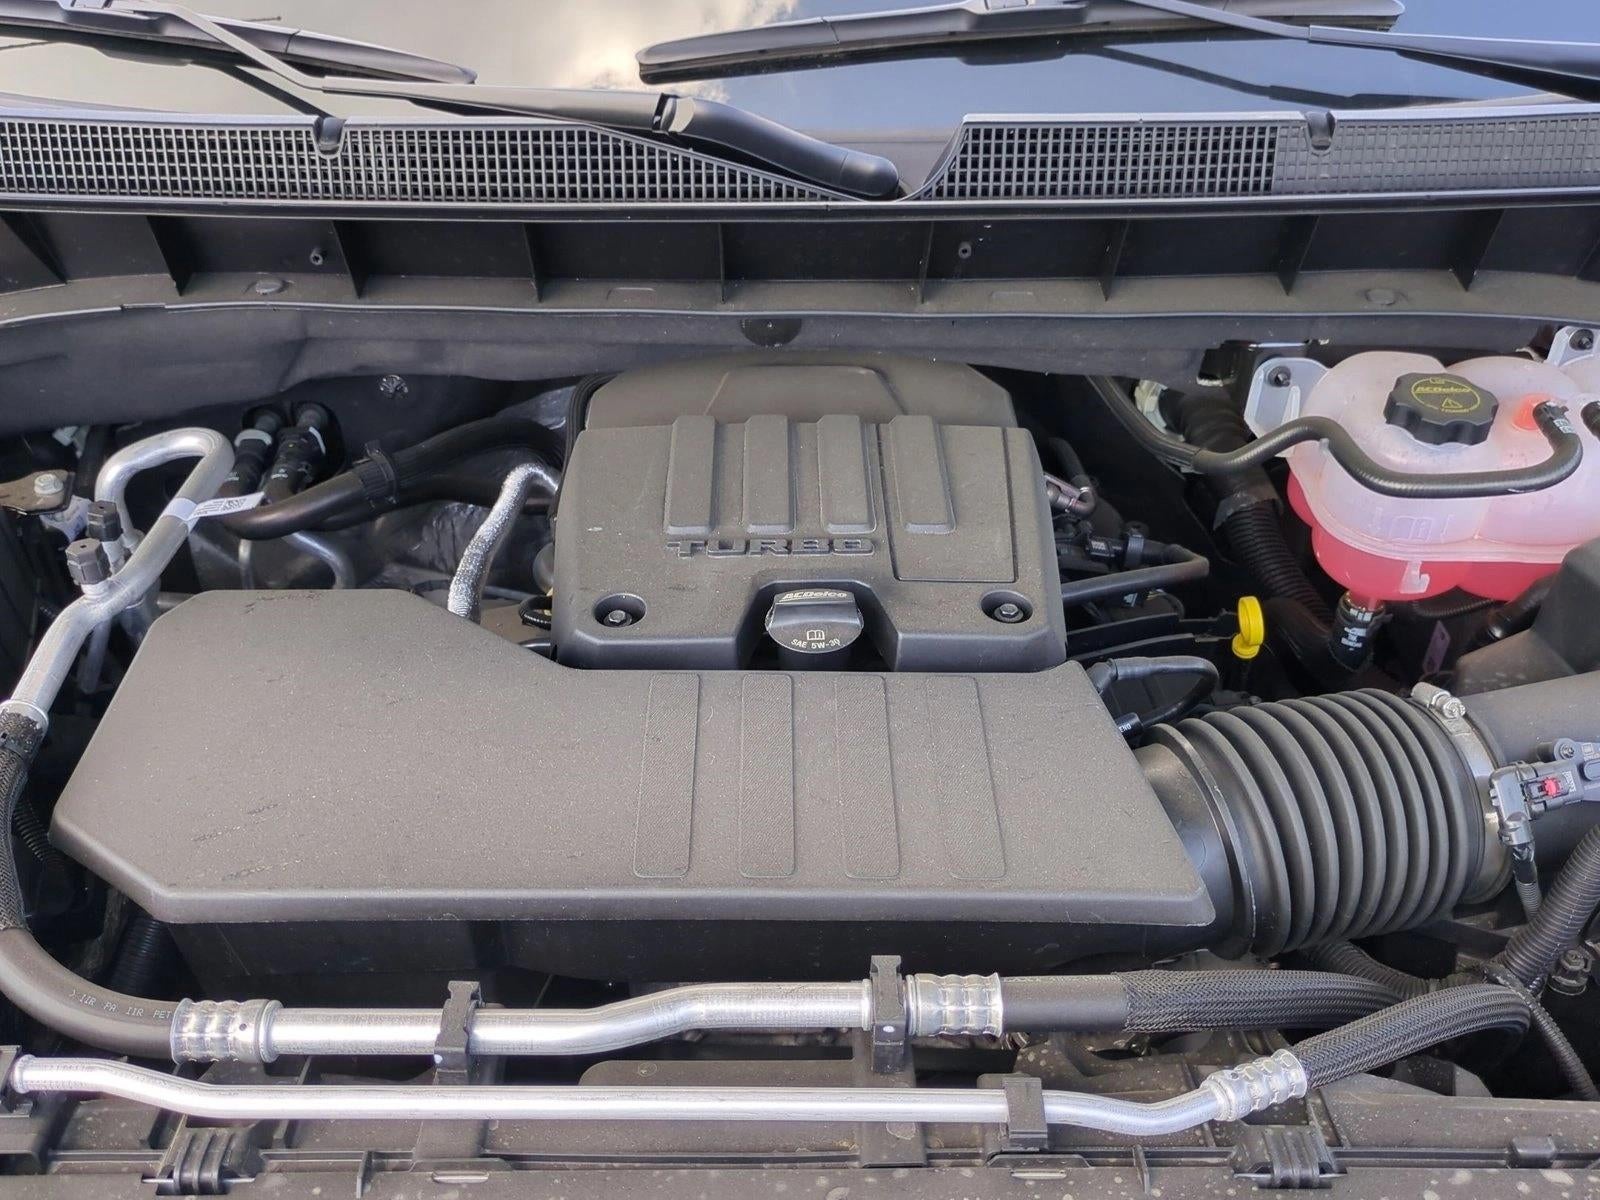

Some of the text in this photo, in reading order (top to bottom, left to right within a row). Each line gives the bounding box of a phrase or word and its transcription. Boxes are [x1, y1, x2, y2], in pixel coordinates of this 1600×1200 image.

[667, 538, 876, 558] TURBO
[781, 591, 848, 600] ACDelco
[791, 638, 841, 649] SAE 5W-30
[153, 1009, 173, 1019] PET
